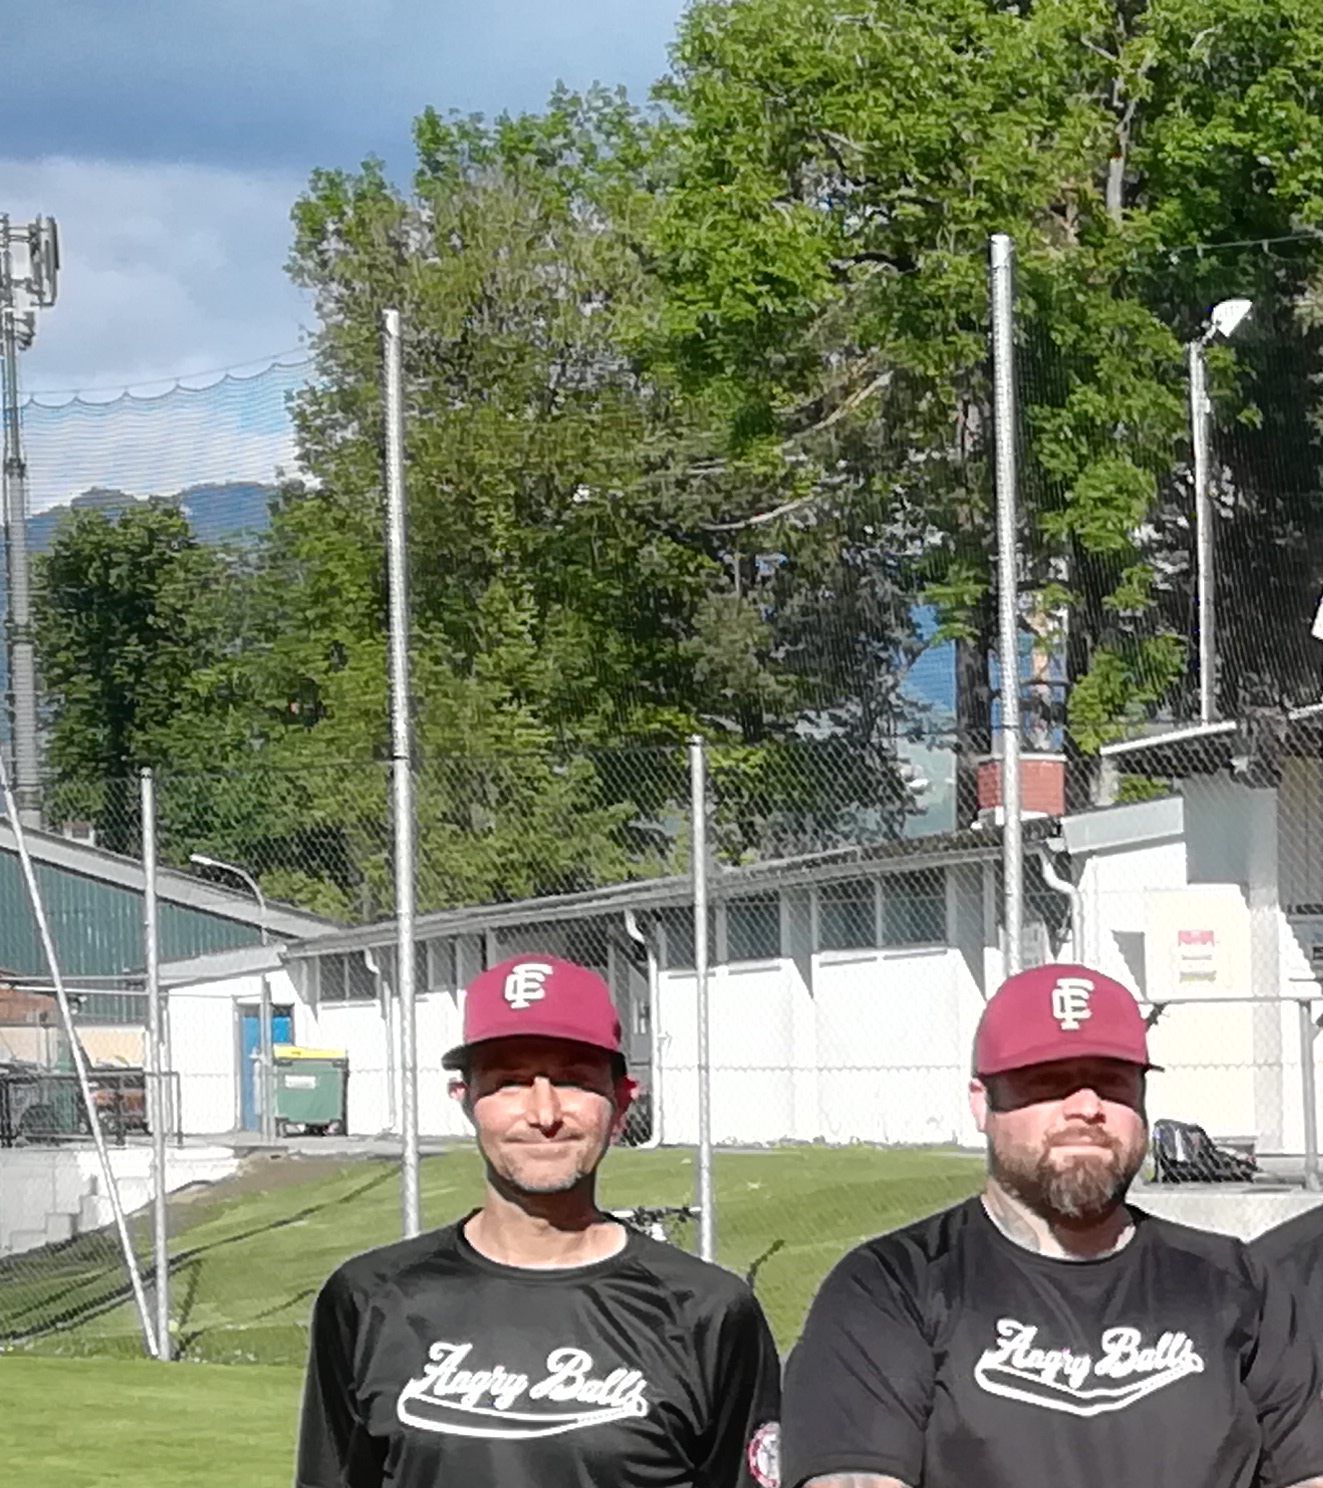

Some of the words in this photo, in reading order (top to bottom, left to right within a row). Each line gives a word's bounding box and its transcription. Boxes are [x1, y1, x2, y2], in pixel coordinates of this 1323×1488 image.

[417, 1341, 528, 1408] Angry
[530, 1347, 648, 1412] Balls
[989, 1318, 1091, 1389] Angry
[1094, 1327, 1204, 1378] Balls
